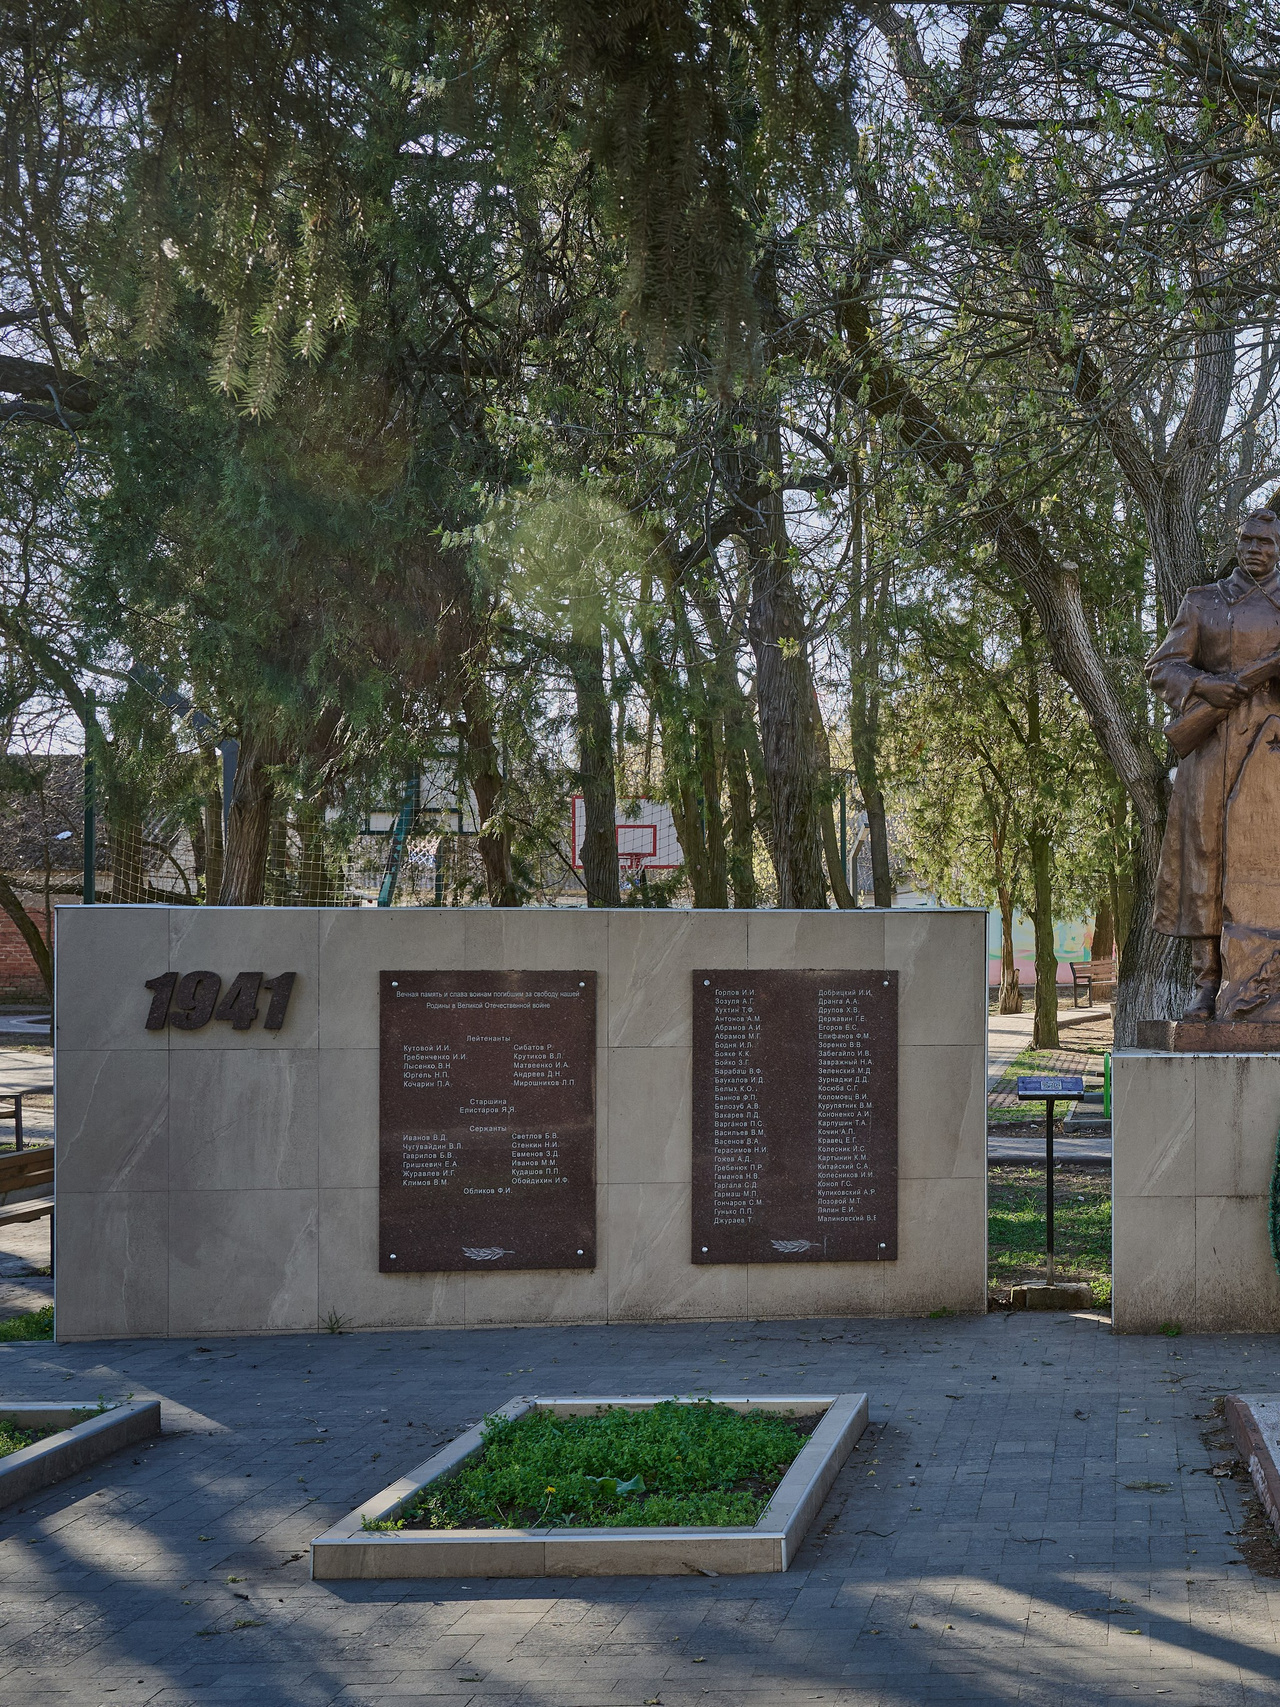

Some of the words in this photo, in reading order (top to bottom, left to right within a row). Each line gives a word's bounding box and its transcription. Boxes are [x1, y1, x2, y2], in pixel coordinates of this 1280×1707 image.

[534, 991, 558, 999] свободу
[144, 971, 297, 1030] 1941
[513, 1053, 547, 1061] Крутиков
[513, 1079, 559, 1087] Мирошников
[469, 1098, 507, 1106] Старшина
[469, 1125, 507, 1133] Сержанты
[402, 1152, 437, 1160] Гаврилов
[402, 1161, 442, 1169] Гришкевич
[402, 1170, 440, 1178] Журавлев
[512, 1168, 543, 1176] Кудашов
[818, 1189, 861, 1197] Куликовский
